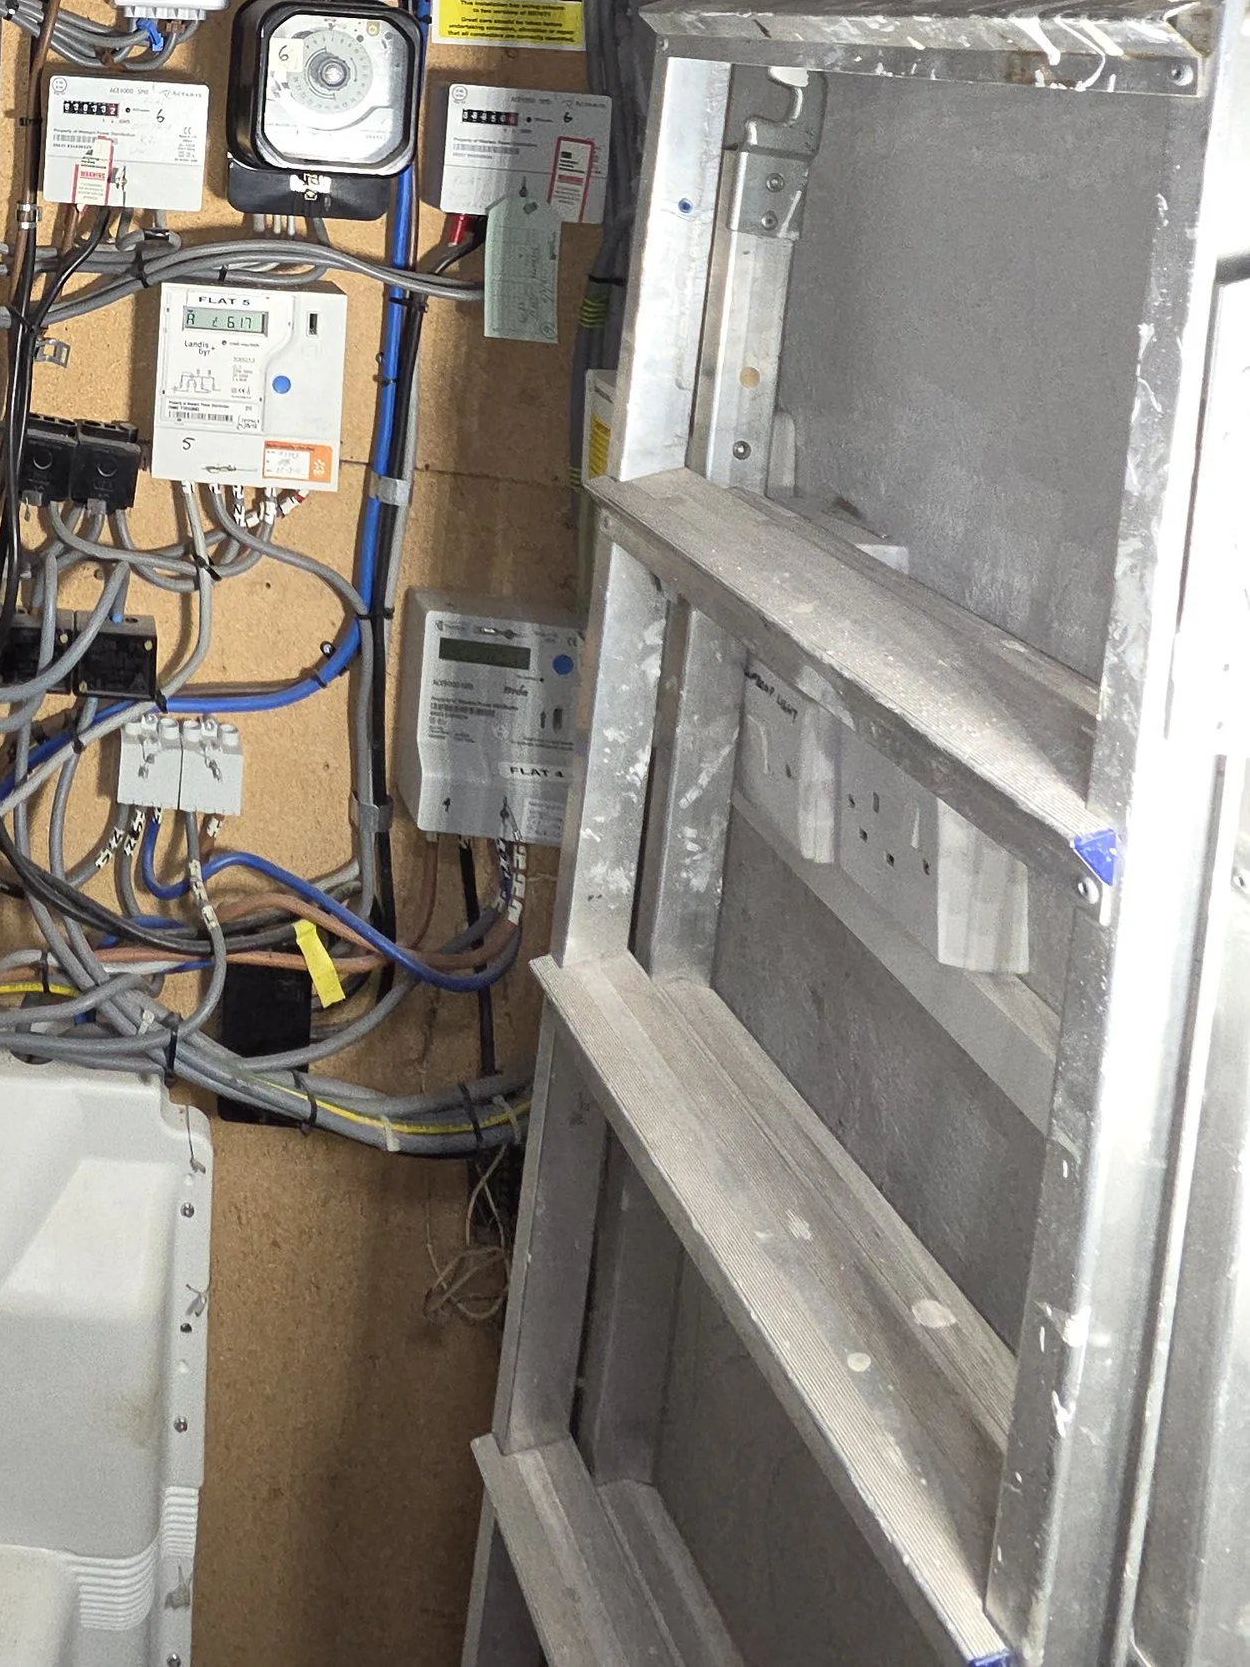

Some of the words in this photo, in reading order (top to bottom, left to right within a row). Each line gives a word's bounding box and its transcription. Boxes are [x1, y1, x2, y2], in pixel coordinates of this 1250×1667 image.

[156, 109, 166, 123] 6
[199, 296, 237, 305] FLAT
[184, 340, 209, 349] Landis
[182, 436, 196, 451] 5
[510, 766, 549, 777] FLAT
